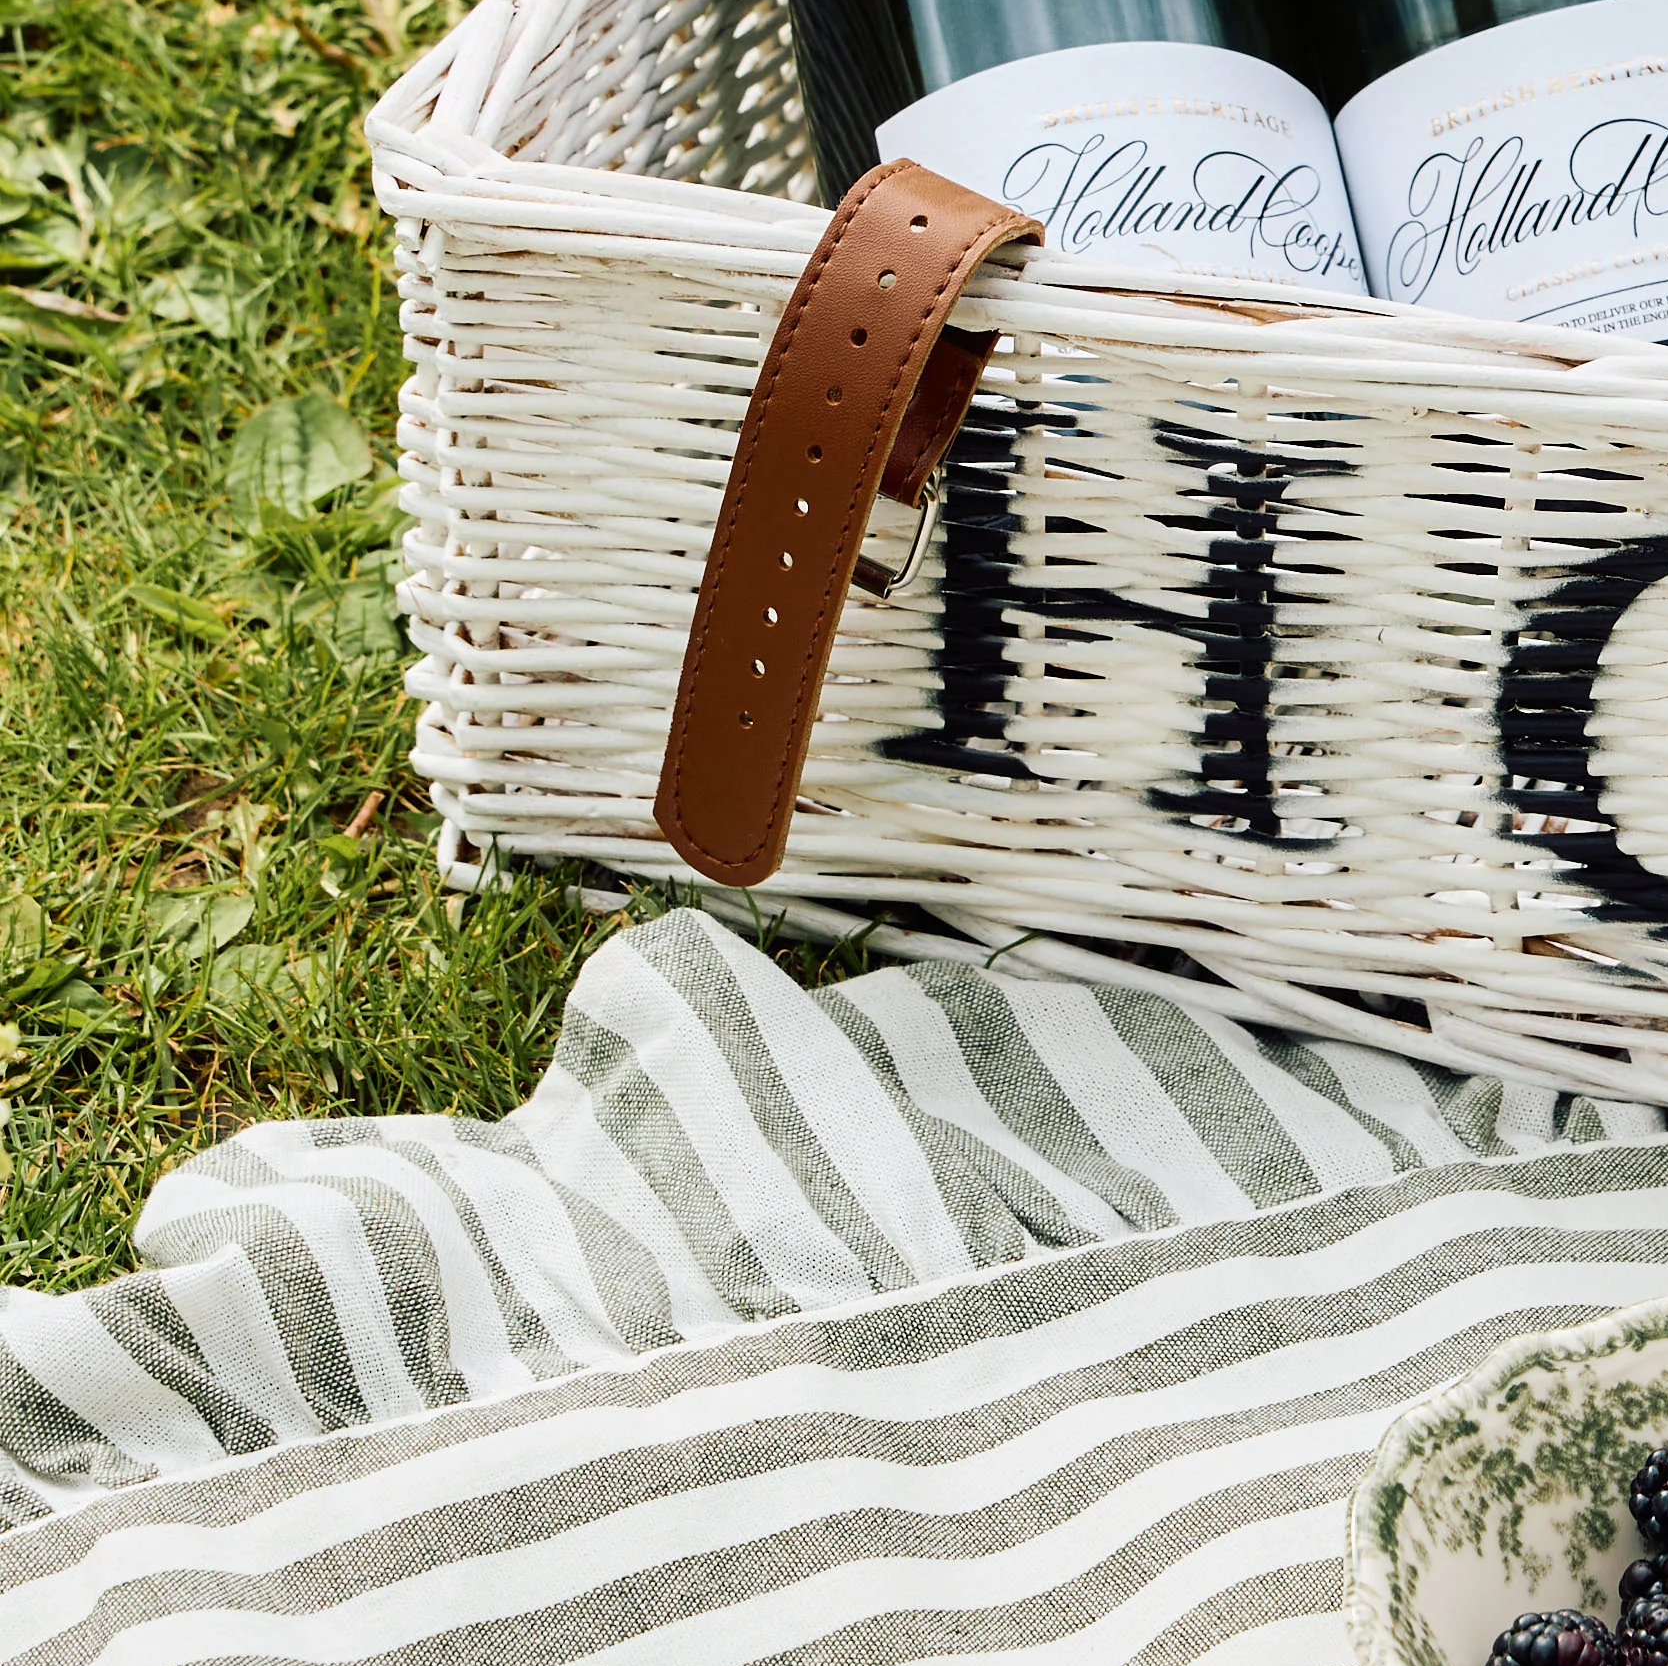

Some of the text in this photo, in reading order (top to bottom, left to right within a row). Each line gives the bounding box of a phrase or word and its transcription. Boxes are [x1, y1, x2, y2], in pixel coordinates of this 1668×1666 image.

[1041, 97, 1295, 140] BRITISH HERITAGE
[1429, 81, 1538, 137] BRITISH
[1003, 133, 1267, 255] Holland
[1387, 119, 1655, 304] Holland
[1505, 258, 1604, 302] CLASSIC
[1571, 316, 1586, 328] TO
[1588, 303, 1637, 323] DELIVER
[1639, 297, 1663, 311] OUR
[1603, 321, 1616, 333] IN
[1616, 316, 1642, 330] THE
